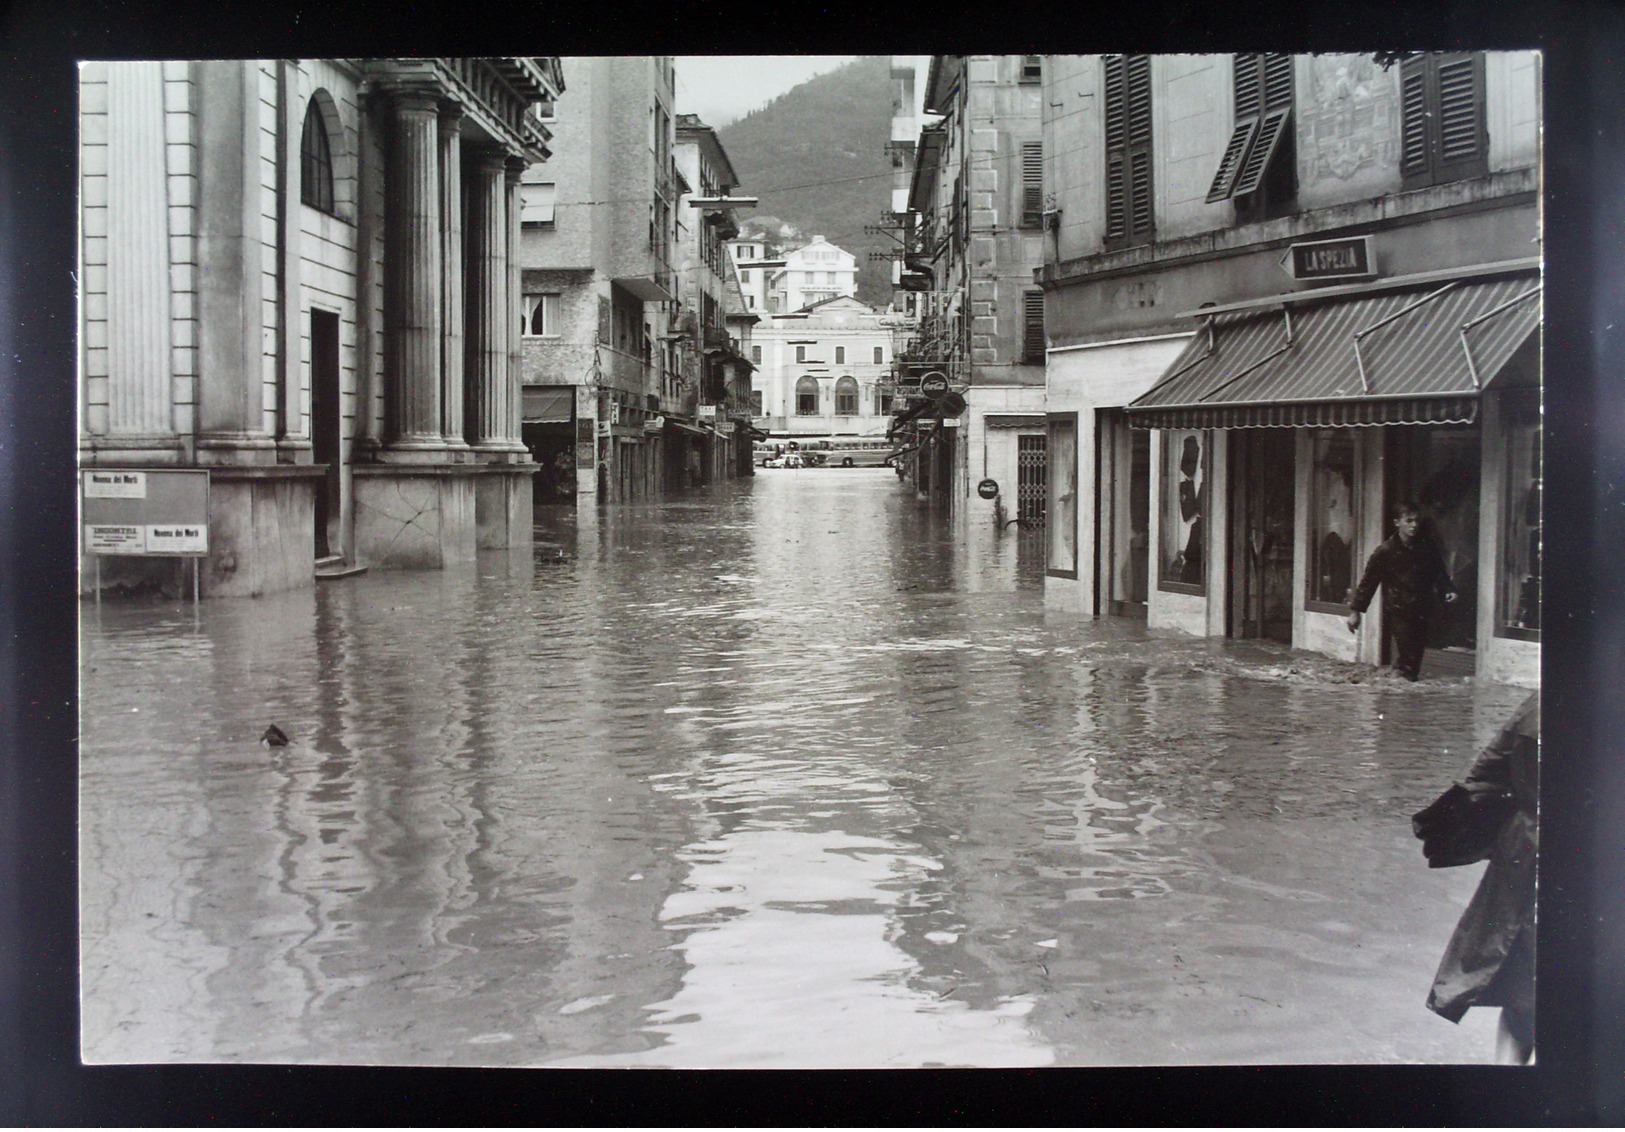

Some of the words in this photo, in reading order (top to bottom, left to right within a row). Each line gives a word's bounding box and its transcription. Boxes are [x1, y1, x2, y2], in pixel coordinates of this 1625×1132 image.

[1305, 251, 1318, 271] LA
[1320, 247, 1357, 270] SPEZIA
[114, 475, 122, 483] dei
[124, 475, 138, 483] Morti
[154, 529, 173, 537] Novena
[175, 529, 183, 537] dei
[185, 529, 199, 537] Morti
